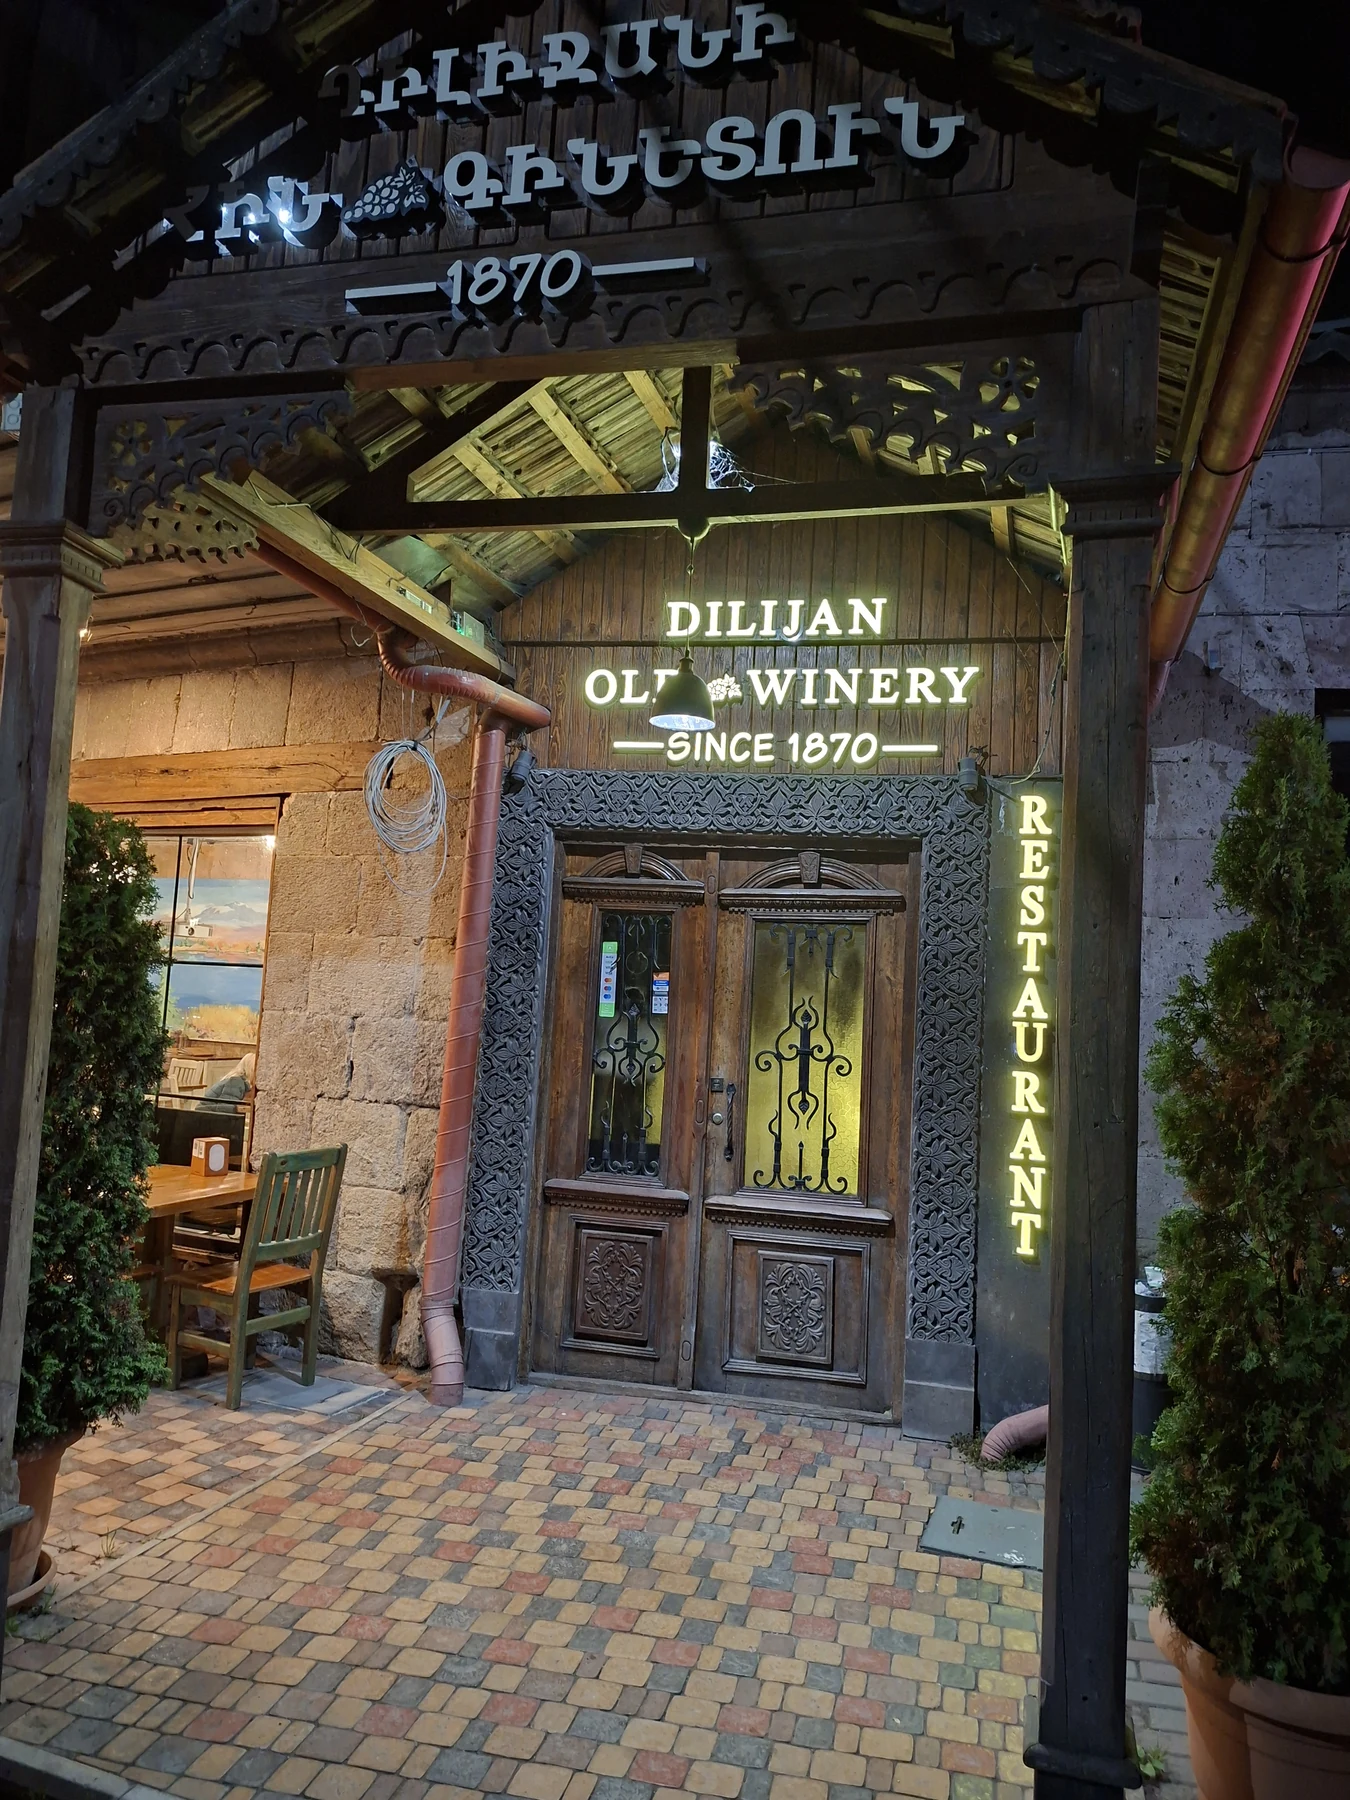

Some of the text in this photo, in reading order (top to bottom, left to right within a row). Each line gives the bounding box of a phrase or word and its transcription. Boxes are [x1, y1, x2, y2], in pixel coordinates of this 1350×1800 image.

[446, 248, 583, 306] 1870
[666, 597, 888, 642] DILIJAN
[746, 666, 980, 705] WINERY
[666, 731, 878, 764] SINCE 1870
[1010, 795, 1052, 1257] RESTAURANT
